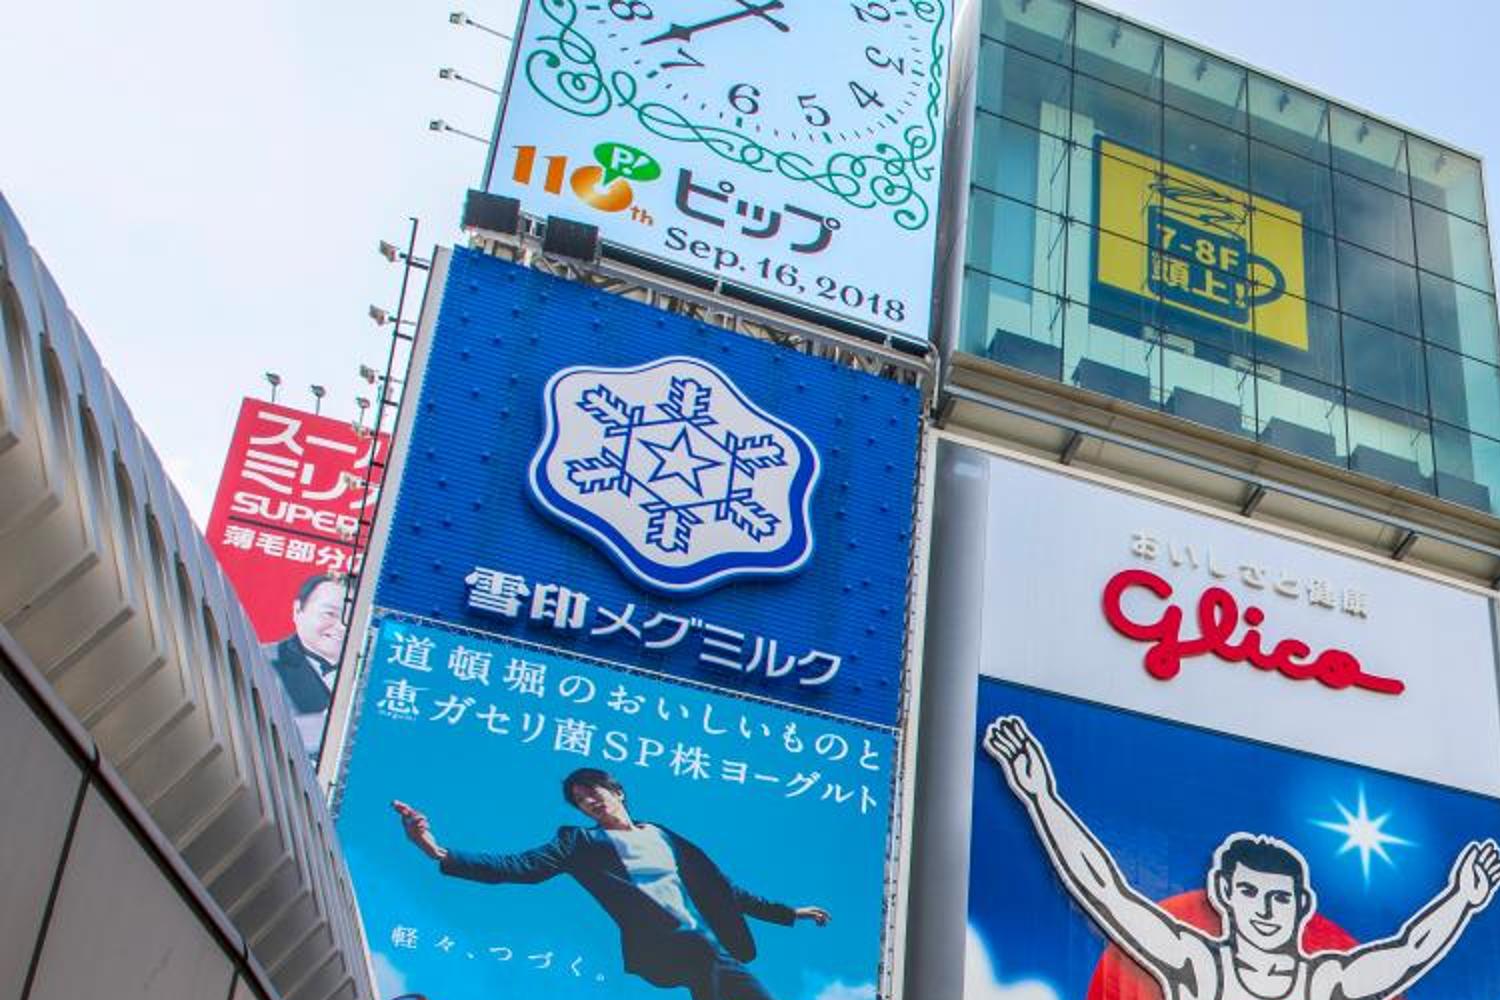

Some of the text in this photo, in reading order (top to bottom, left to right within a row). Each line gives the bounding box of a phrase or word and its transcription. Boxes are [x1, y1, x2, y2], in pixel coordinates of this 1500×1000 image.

[848, 80, 885, 110] 4
[865, 45, 905, 76] 3
[727, 83, 761, 115] 6
[796, 94, 831, 127] 5
[674, 167, 843, 255] ピップ
[1156, 223, 1241, 272] 7-8F
[664, 225, 906, 323] Sep. 16, 2018
[1130, 530, 1368, 619] おいしさと健康
[463, 564, 844, 687] 雪印メグミルク
[1101, 568, 1406, 696] Glico
[386, 630, 882, 773] 道頓堀のおいしいものと
[390, 925, 607, 983] 軽々、つづく。
